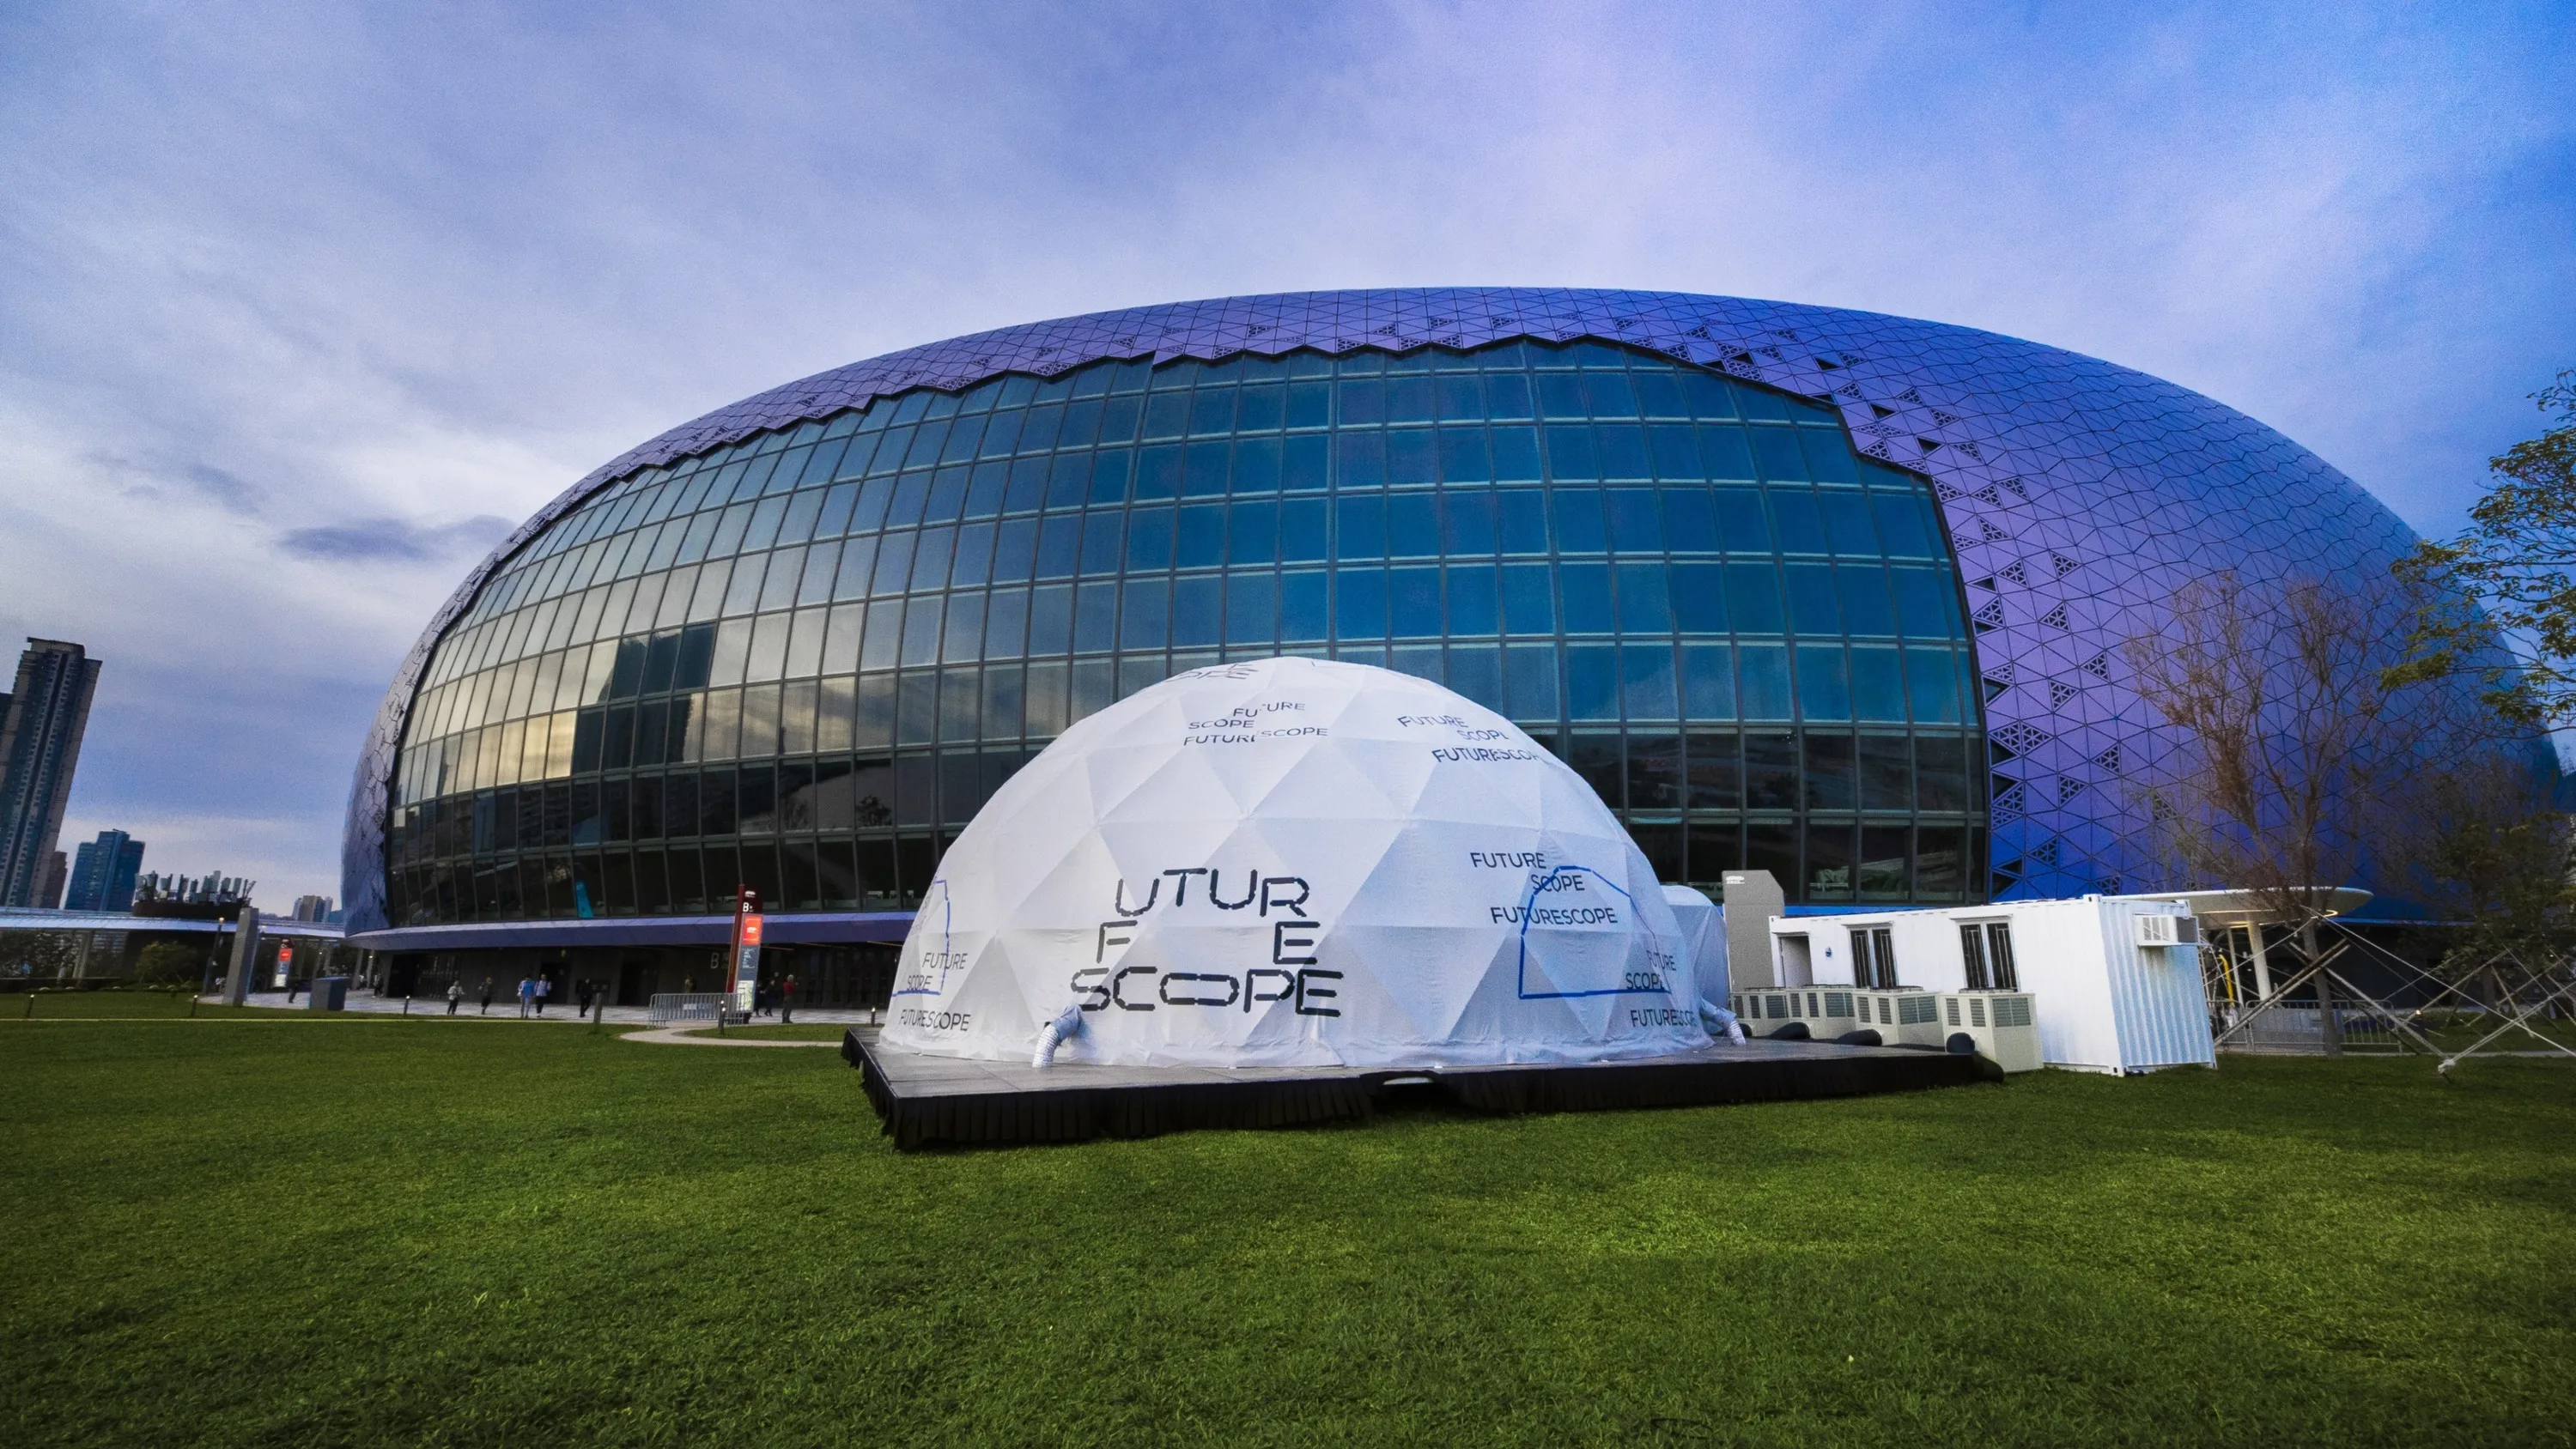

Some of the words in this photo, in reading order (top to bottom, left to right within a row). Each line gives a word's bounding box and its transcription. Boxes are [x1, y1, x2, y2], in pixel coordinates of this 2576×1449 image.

[1188, 718, 1255, 729] SCOPE
[1397, 715, 1468, 728] FUTURE
[1470, 852, 1546, 869] FUTURE
[1531, 874, 1585, 892] SCOPE
[743, 902, 750, 912] B
[1490, 906, 1618, 924] FUTURESCOPE
[922, 952, 969, 970] FUTURE
[1071, 966, 1344, 1017] SCOPE
[900, 1008, 971, 1032] FUTURESCOPE
